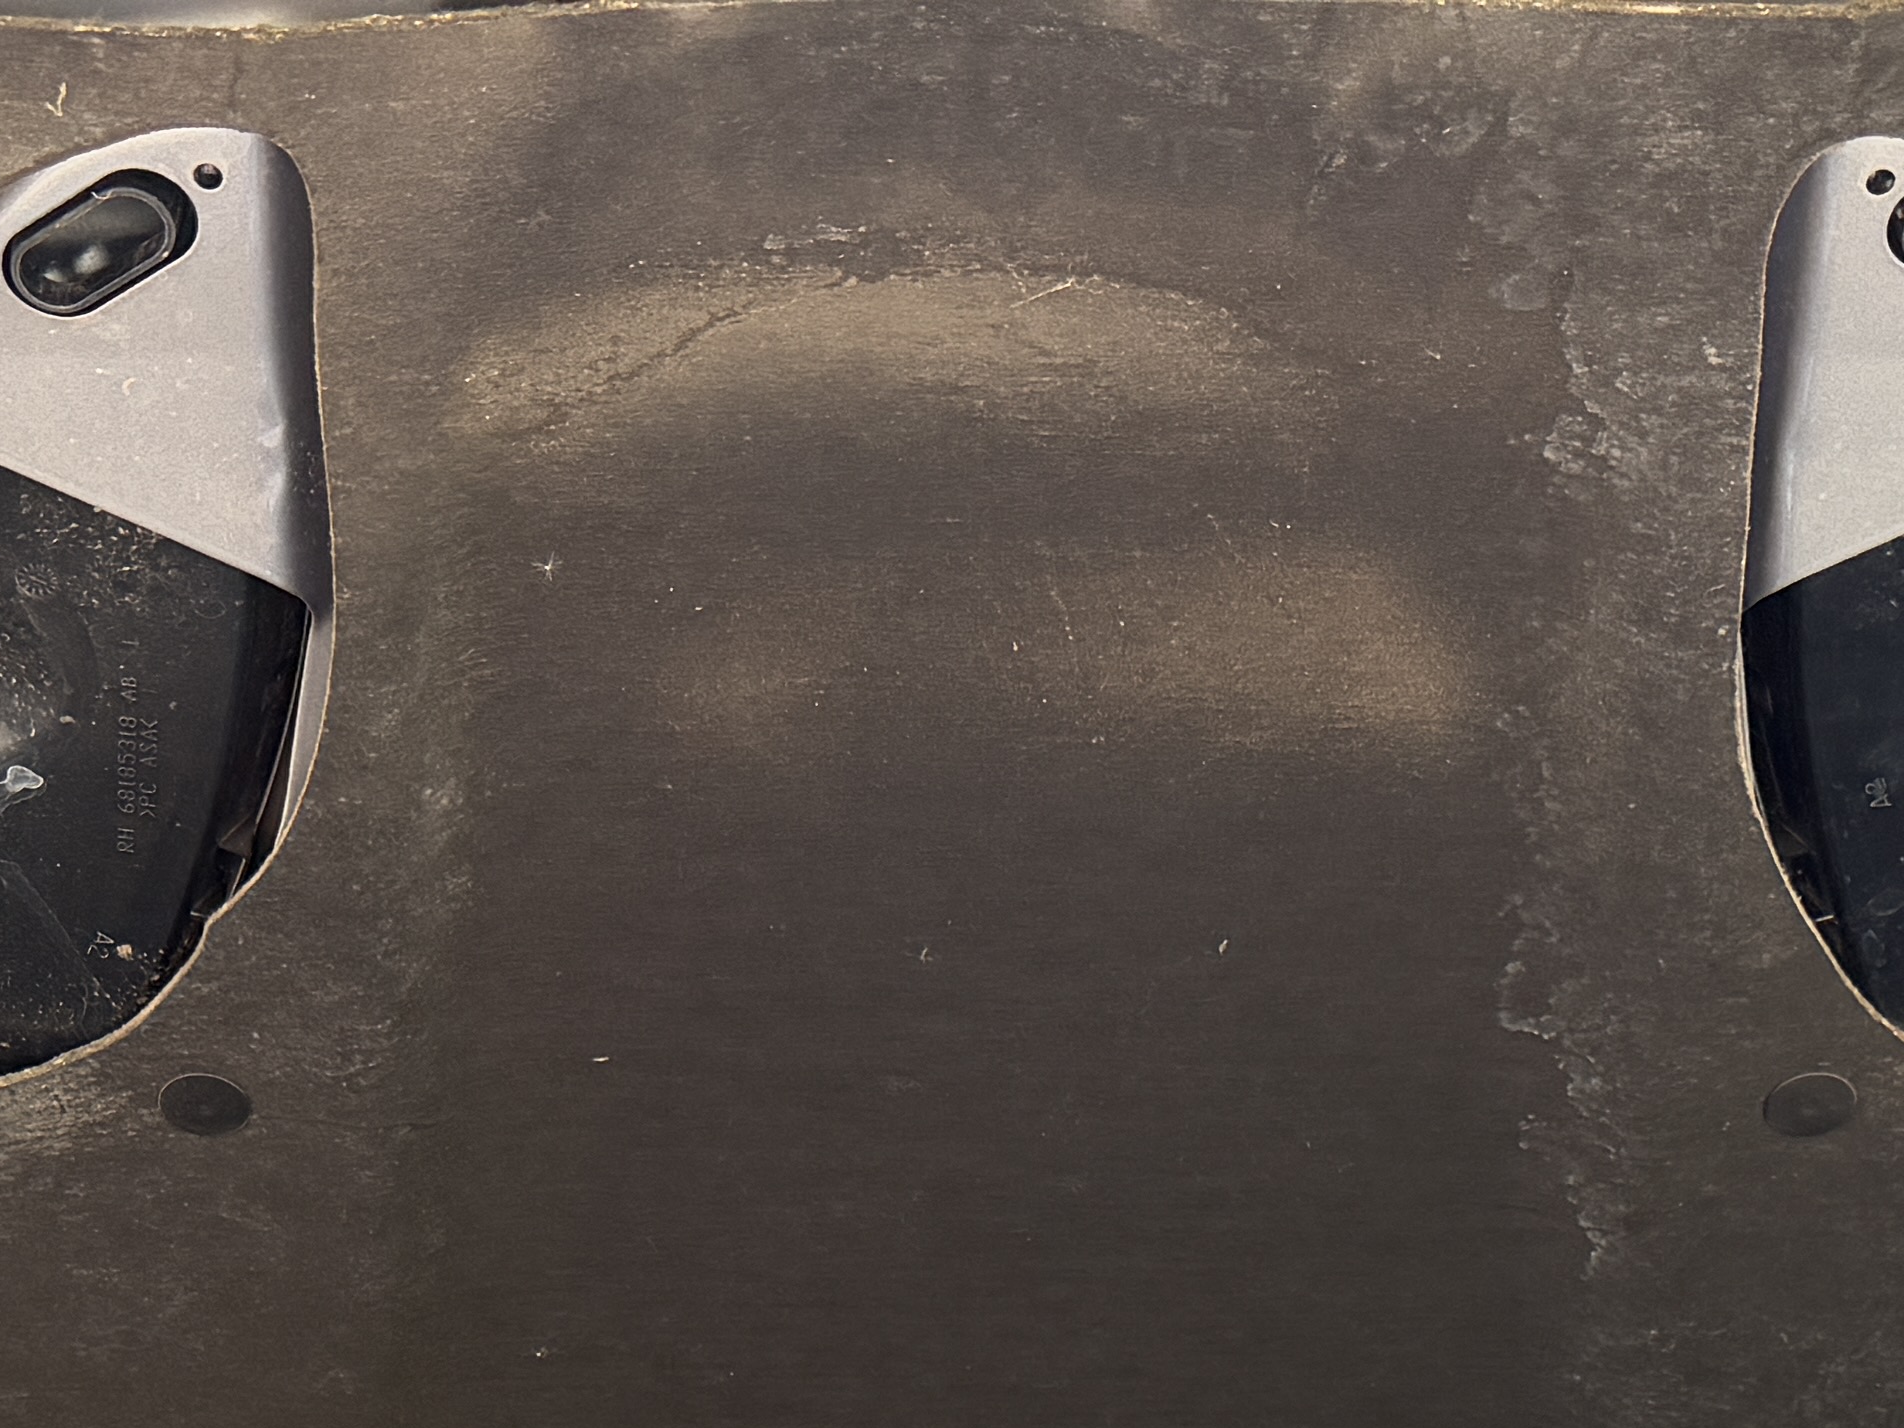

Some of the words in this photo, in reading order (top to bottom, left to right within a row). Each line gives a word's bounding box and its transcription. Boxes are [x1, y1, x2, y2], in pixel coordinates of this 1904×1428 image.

[120, 676, 138, 702] AB
[117, 715, 138, 814] 68185318
[117, 827, 135, 853] RH
